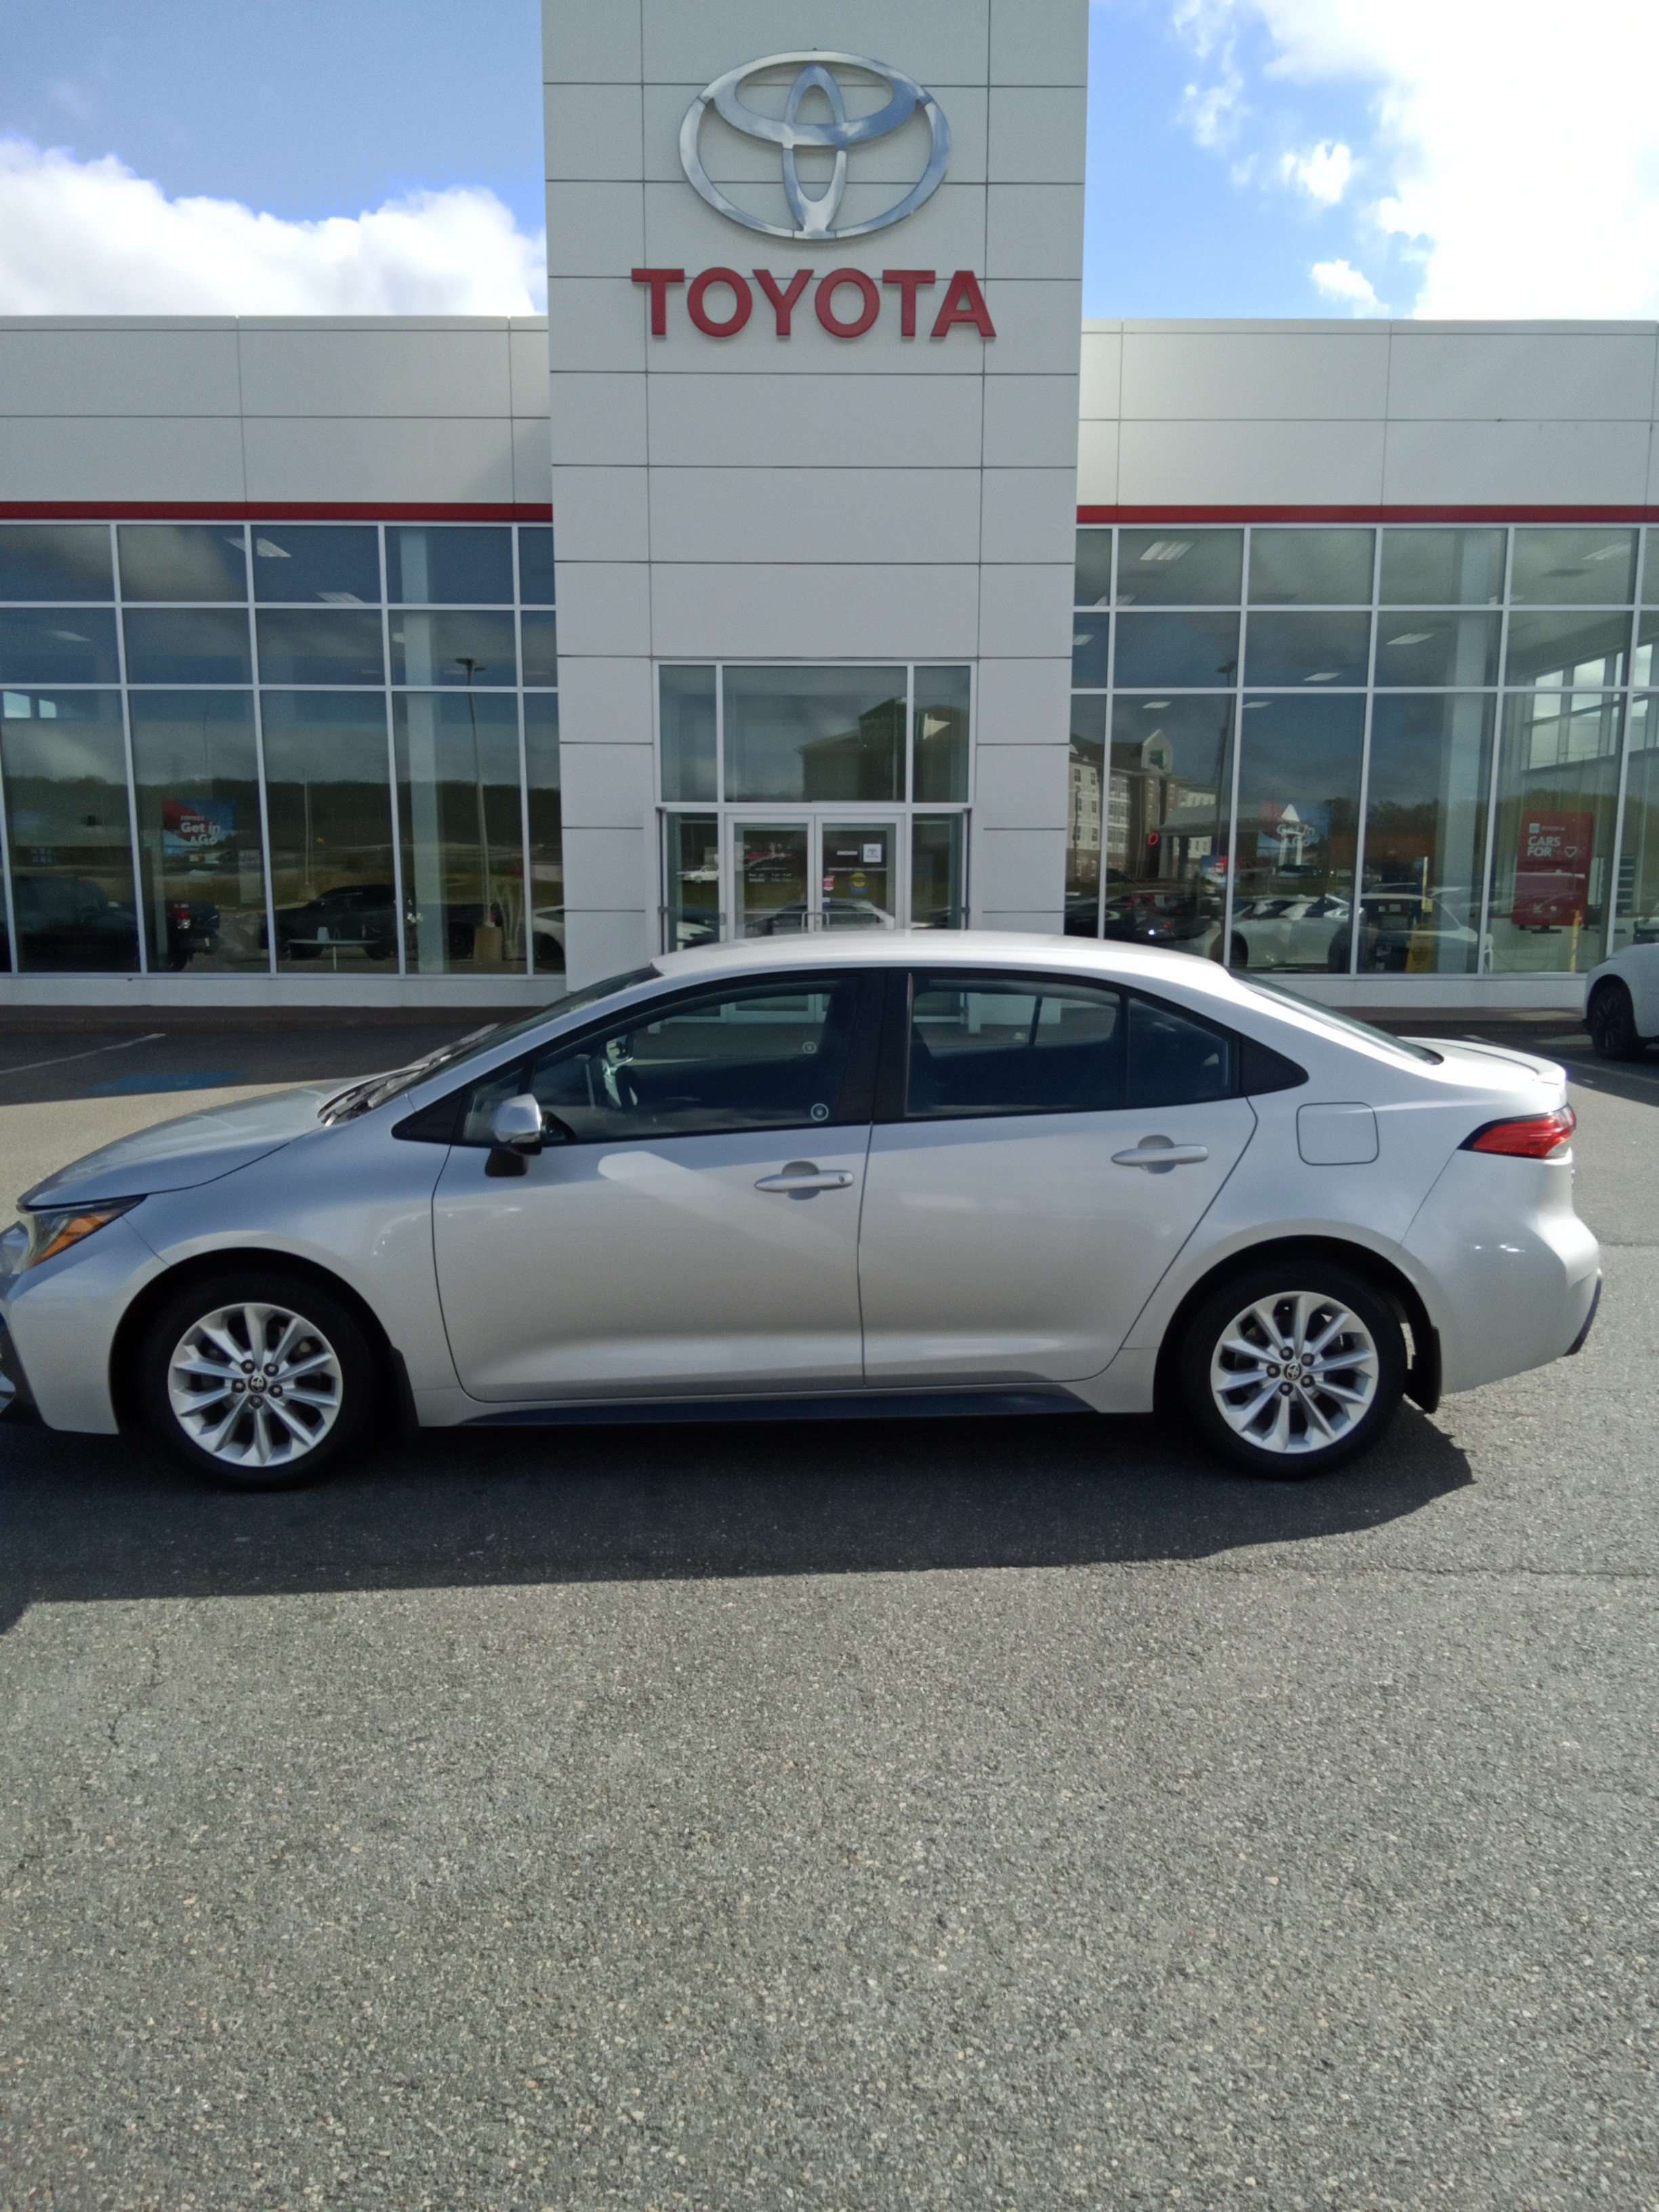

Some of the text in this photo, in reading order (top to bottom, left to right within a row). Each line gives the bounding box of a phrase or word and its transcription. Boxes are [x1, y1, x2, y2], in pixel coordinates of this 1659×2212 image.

[631, 266, 997, 337] TOYOTA
[181, 821, 221, 835] Get in
[1528, 836, 1561, 846] CARS
[1527, 846, 1552, 857] FOR
